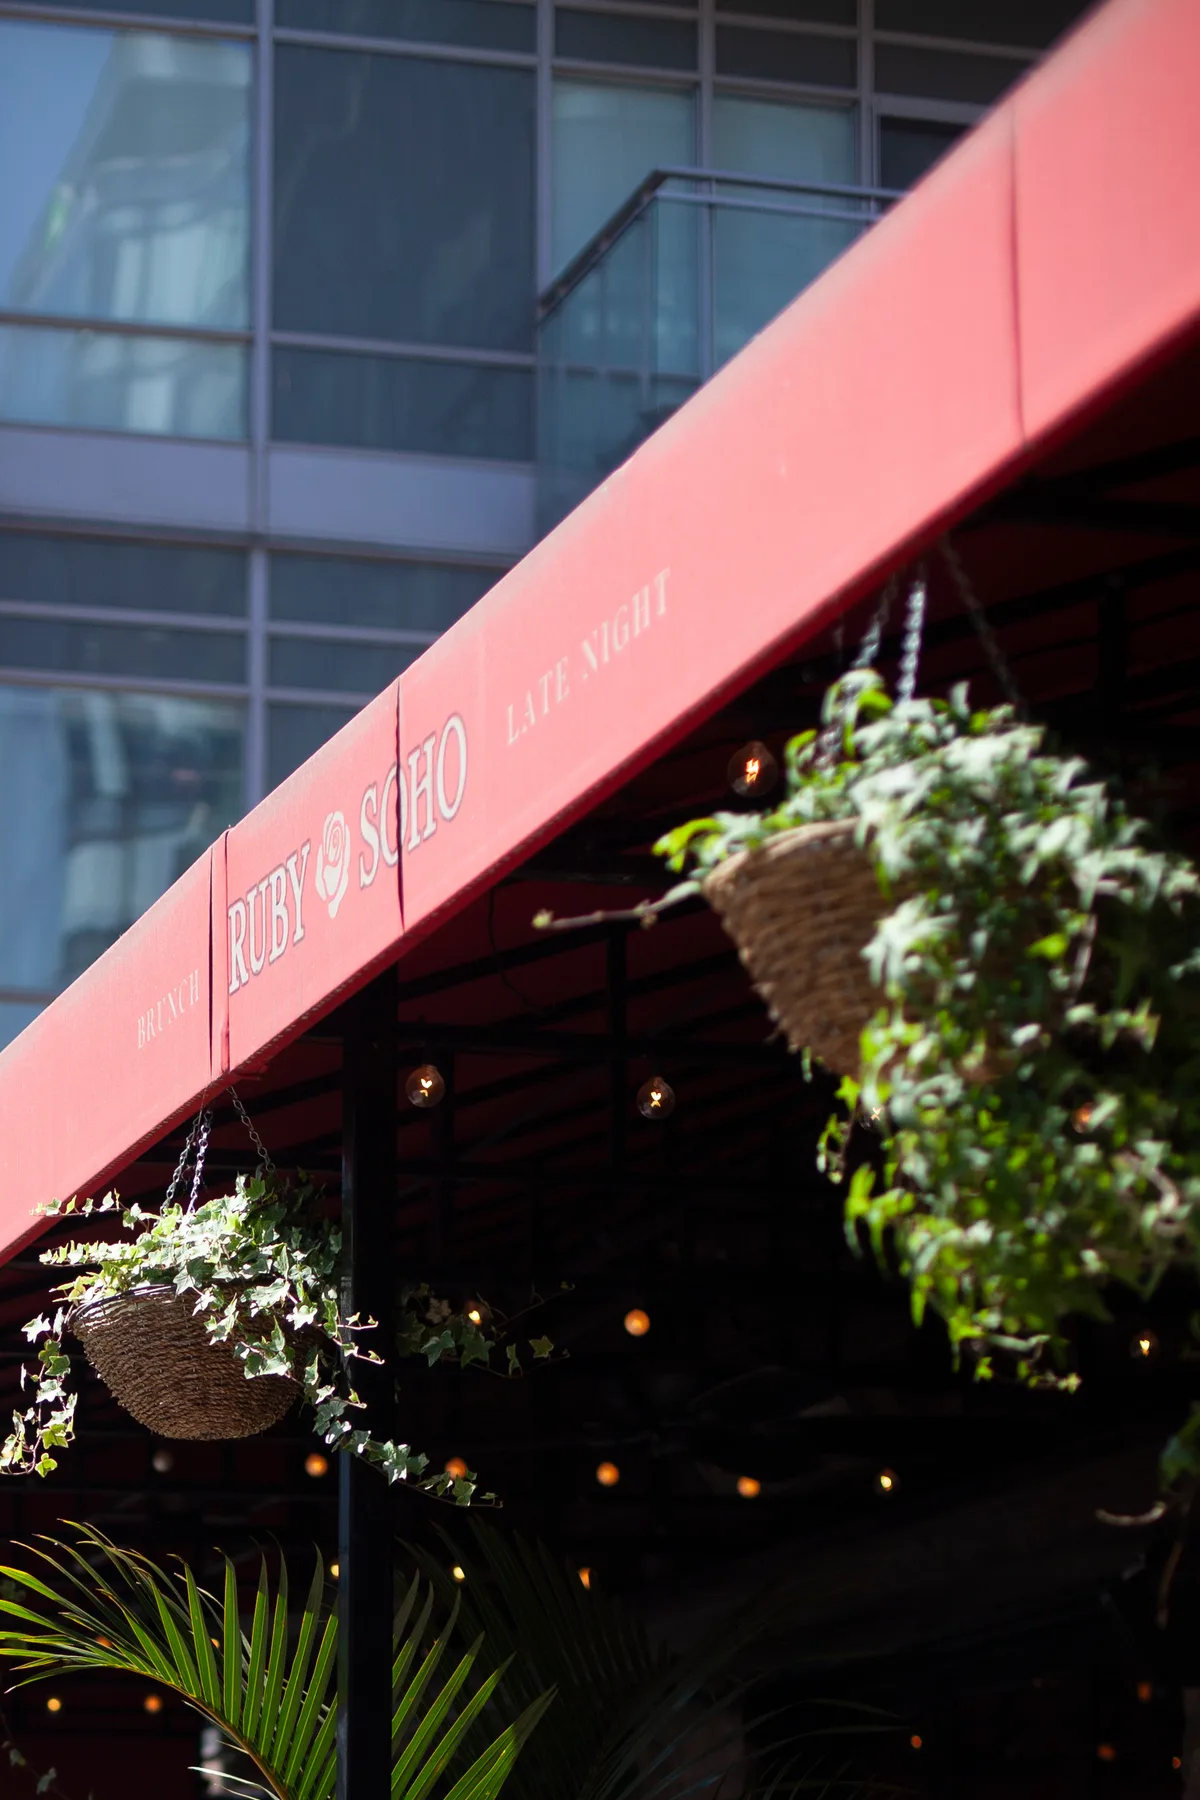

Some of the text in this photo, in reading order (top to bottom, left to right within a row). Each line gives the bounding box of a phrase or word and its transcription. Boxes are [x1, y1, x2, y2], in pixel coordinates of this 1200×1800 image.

[507, 565, 671, 746] LATE NIGHT
[228, 711, 468, 996] RUBY SOHO
[137, 968, 199, 1050] BRUNCH
